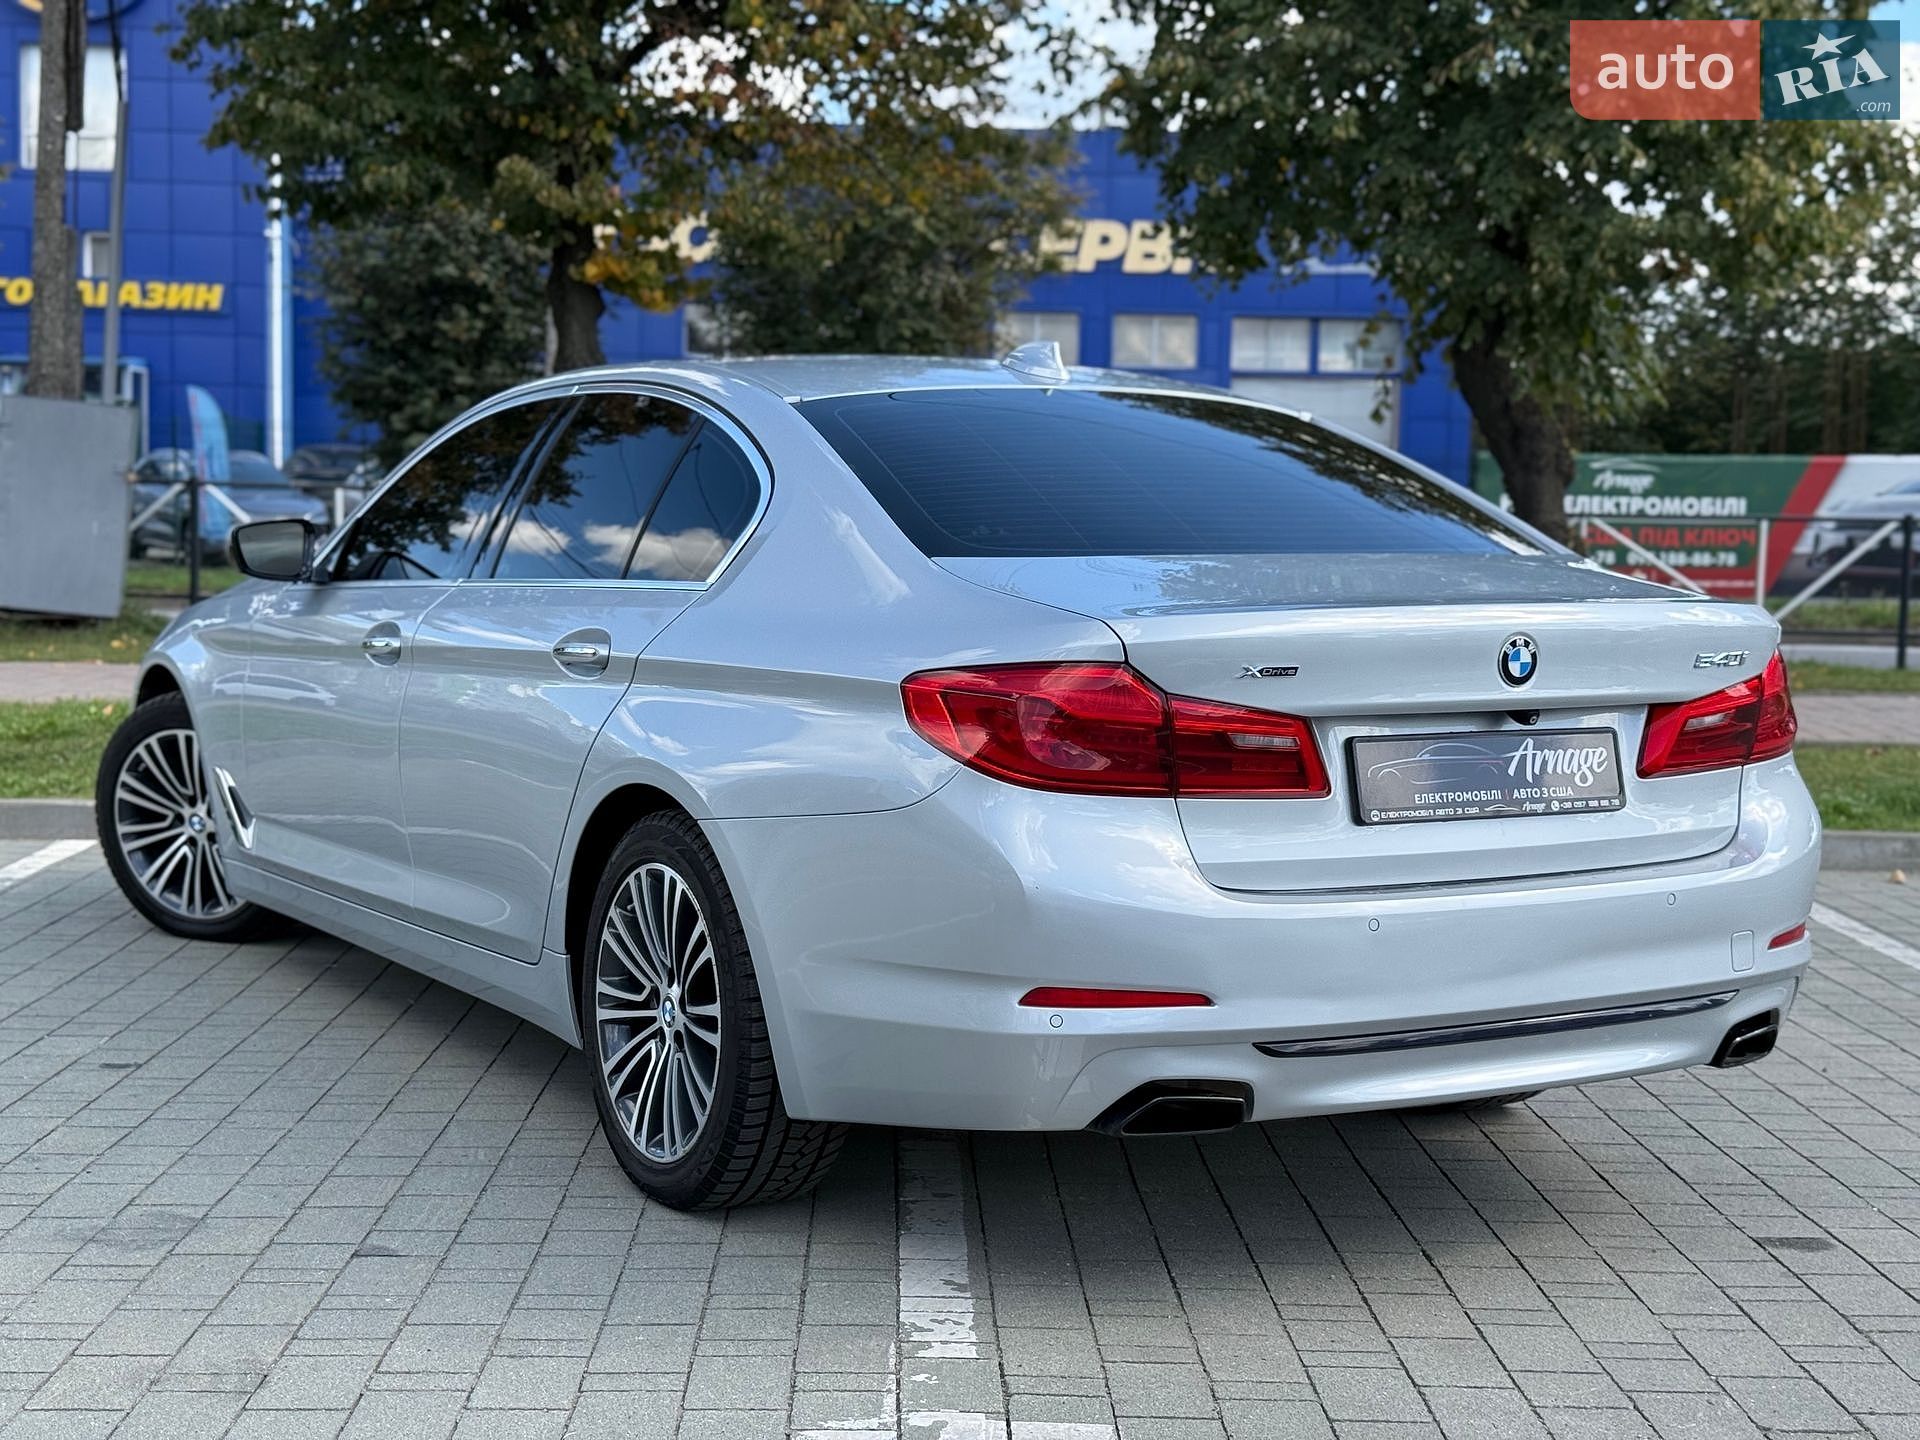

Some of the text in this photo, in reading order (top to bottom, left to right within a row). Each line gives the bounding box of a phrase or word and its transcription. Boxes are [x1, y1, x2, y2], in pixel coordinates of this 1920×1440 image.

[1683, 528, 1757, 547] КЛЮЧ
[1504, 737, 1608, 787] Arnage
[1414, 790, 1502, 804] ЕЛЕКТРОМОБІЛІ
[1512, 788, 1540, 800] АВТО
[1549, 786, 1574, 797] США
